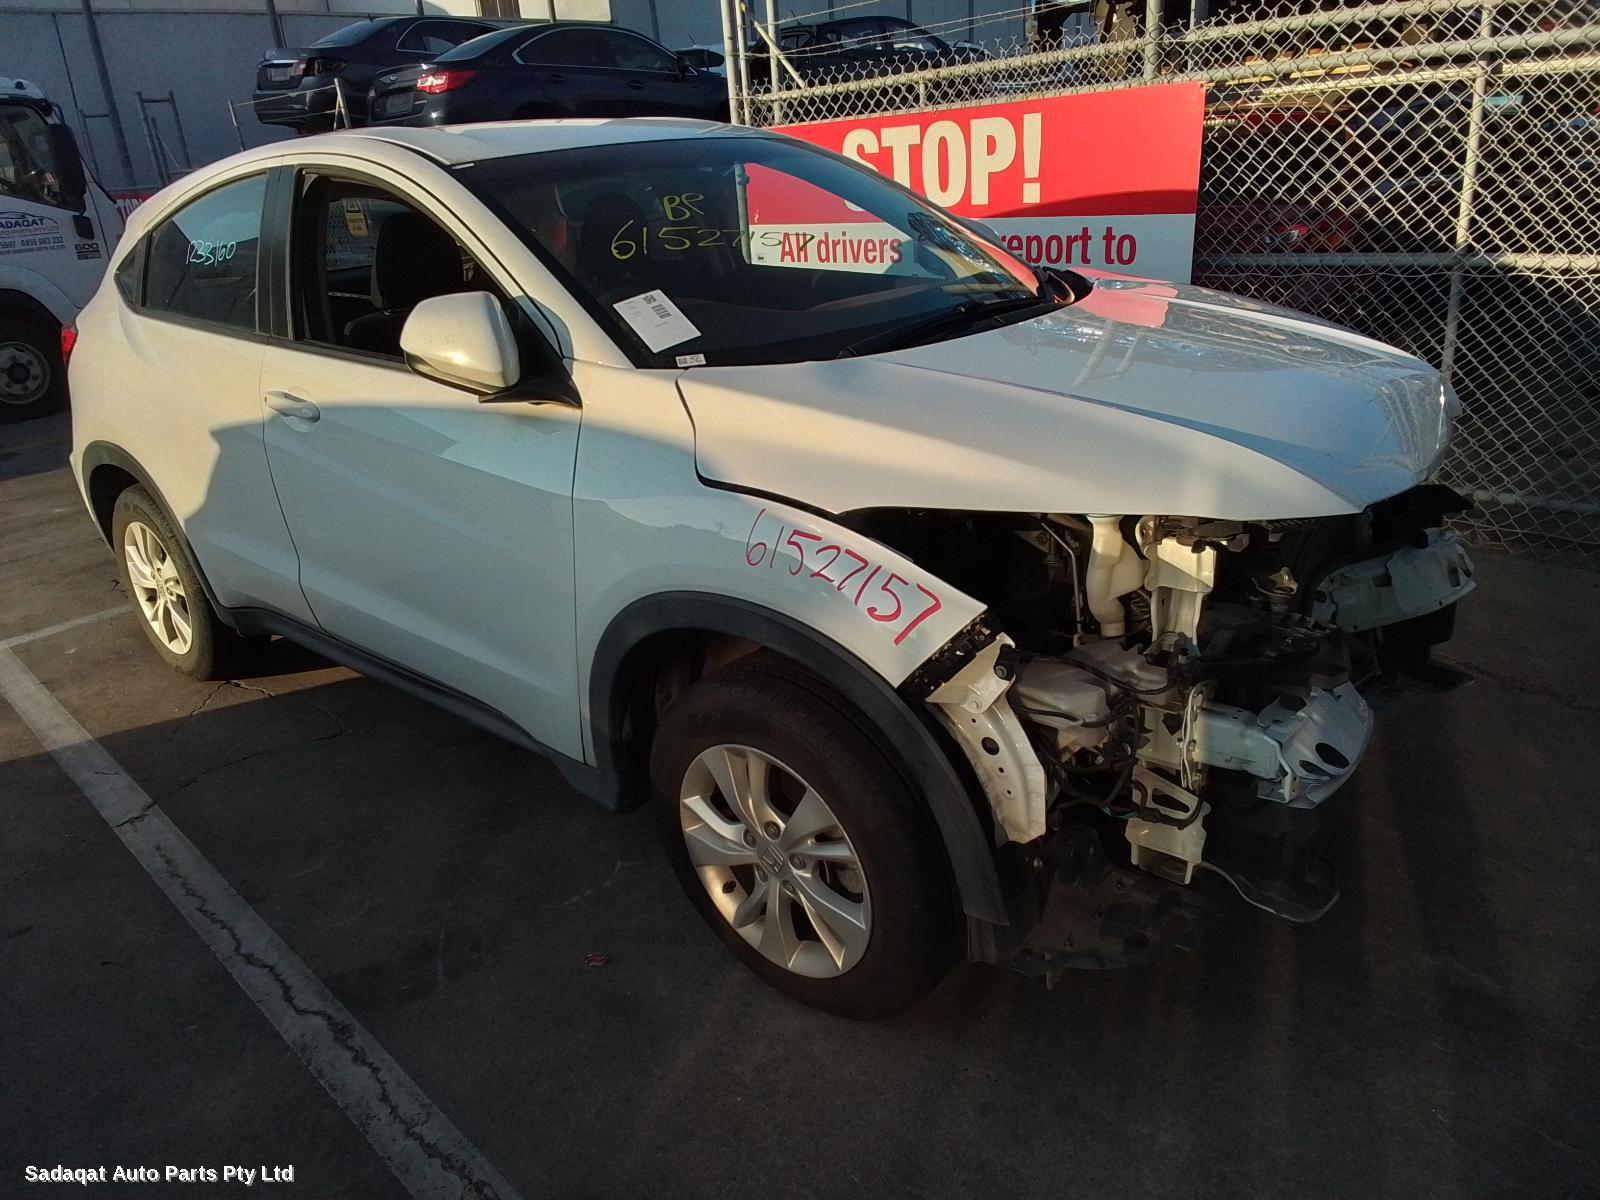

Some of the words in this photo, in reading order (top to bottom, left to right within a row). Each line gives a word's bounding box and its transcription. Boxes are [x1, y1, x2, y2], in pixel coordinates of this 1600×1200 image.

[842, 113, 1042, 211] STOP!
[611, 219, 815, 259] 61527157
[780, 232, 808, 263] All
[816, 231, 904, 264] drivers
[1001, 226, 1092, 264] eport
[1103, 226, 1137, 265] to
[746, 508, 942, 646] 61527157
